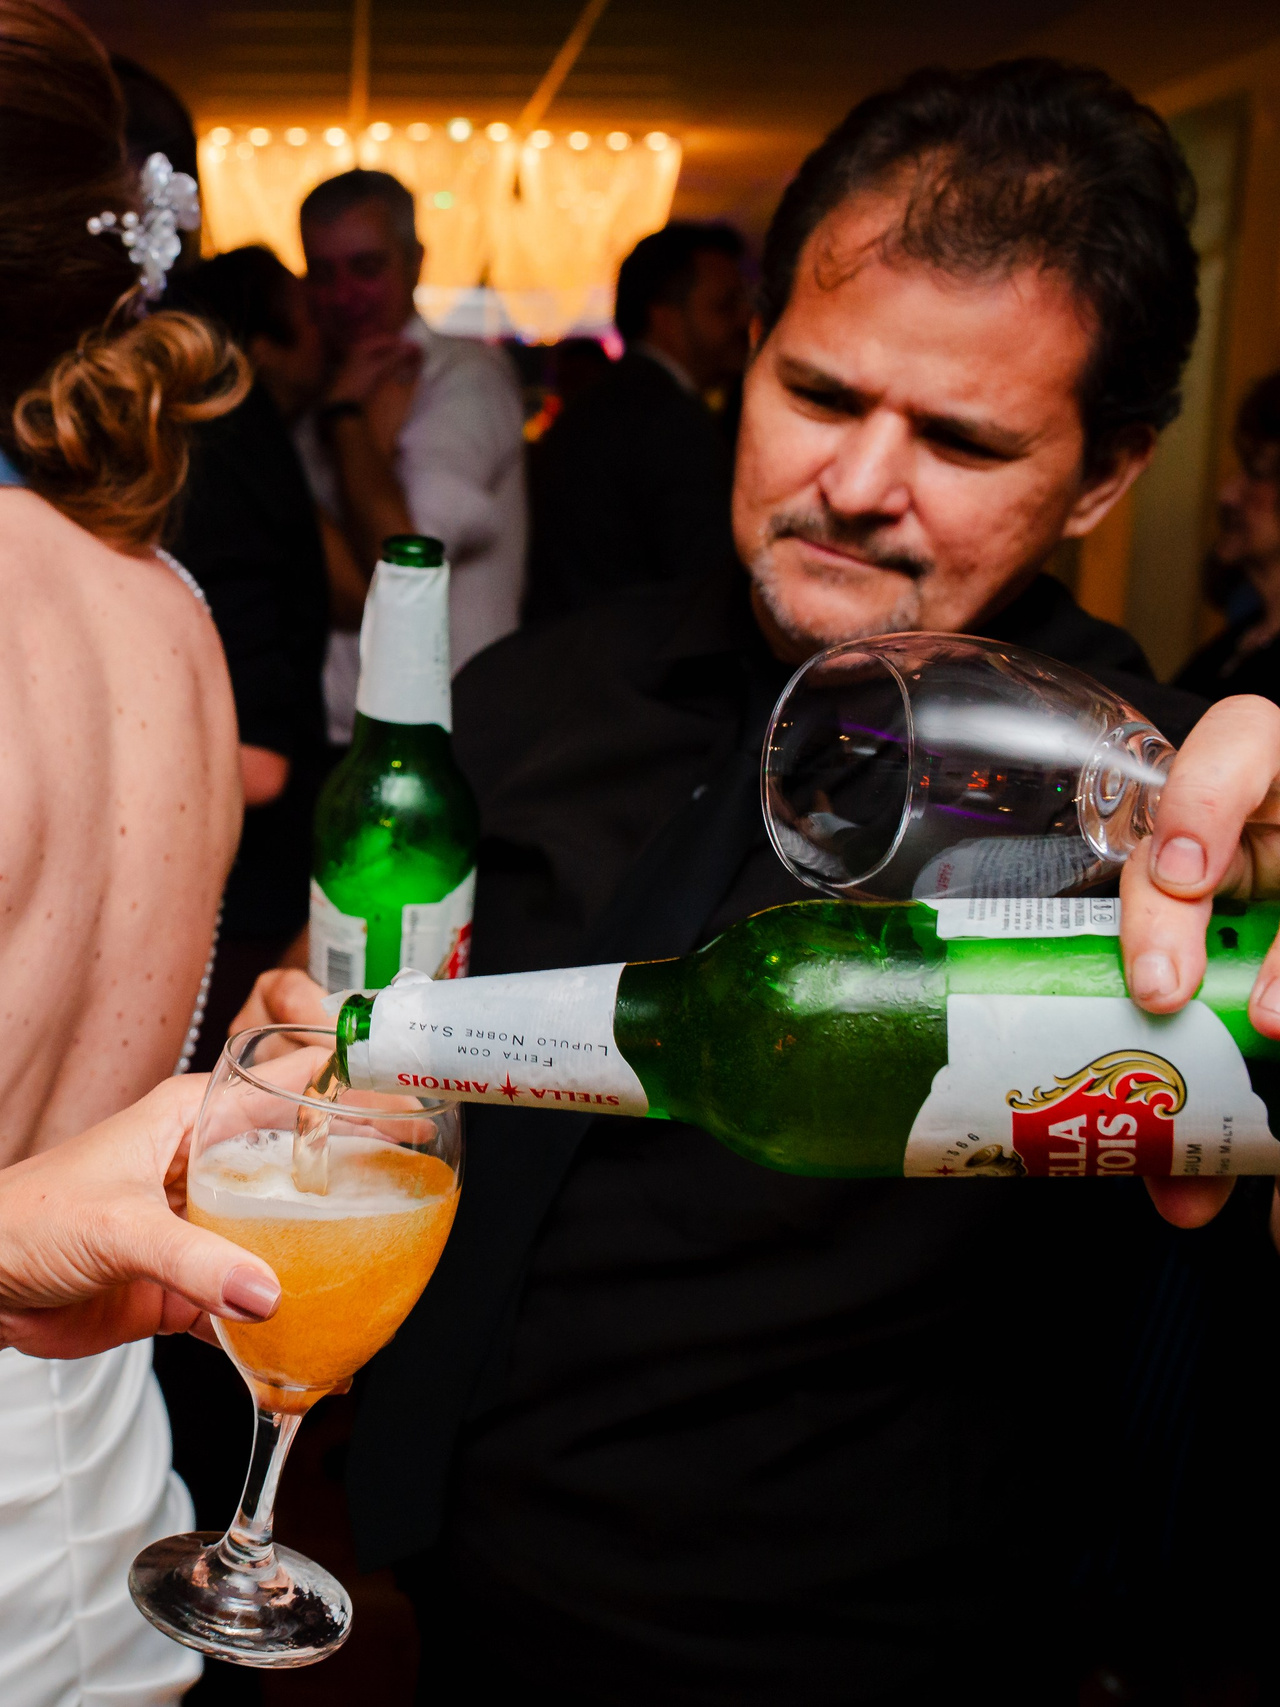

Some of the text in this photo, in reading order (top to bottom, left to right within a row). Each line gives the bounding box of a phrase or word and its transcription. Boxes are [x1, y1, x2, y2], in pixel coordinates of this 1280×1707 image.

[408, 1021, 454, 1038] SAAZ
[465, 1028, 525, 1046] NOBRE
[502, 1051, 553, 1067] FEITA
[397, 1073, 620, 1106] STELLA ARTOIS
[1048, 1113, 1088, 1176] ELLA
[1220, 1116, 1233, 1154] MALTE
